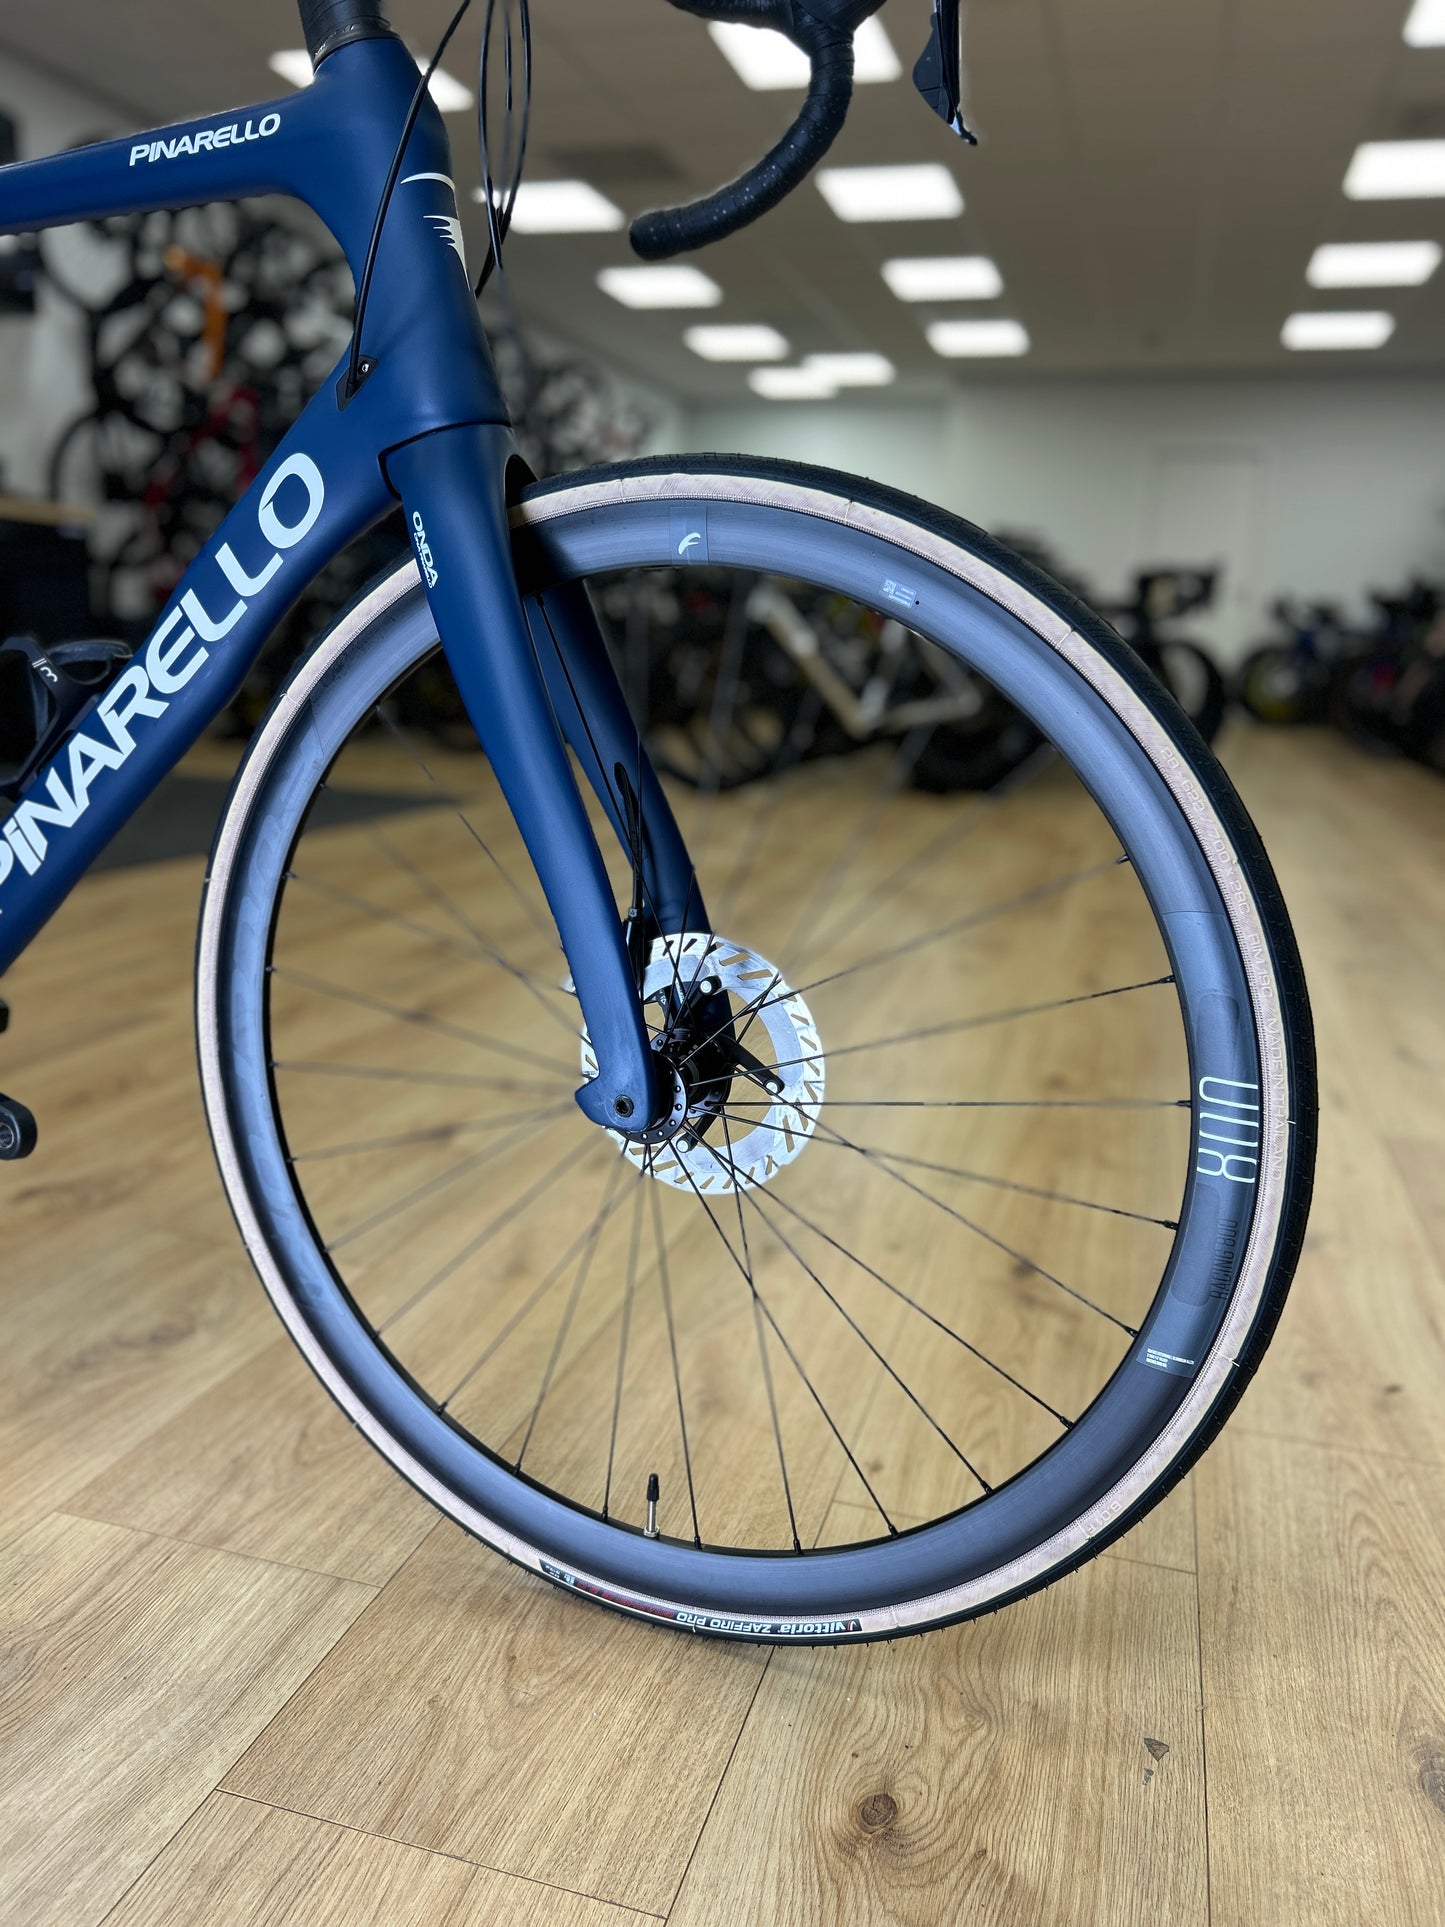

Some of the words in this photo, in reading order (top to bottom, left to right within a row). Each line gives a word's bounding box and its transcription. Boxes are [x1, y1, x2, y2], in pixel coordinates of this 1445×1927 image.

[129, 113, 281, 167] PINARELLO
[413, 511, 439, 587] ONDA
[1160, 747, 1179, 769] 28
[1206, 827, 1230, 863] 700
[1246, 932, 1265, 965] RIM
[1266, 1016, 1283, 1068] MADE
[1271, 1073, 1284, 1089] IN
[1197, 1076, 1259, 1183] 800
[1270, 1094, 1285, 1181] THAILAND
[1217, 1218, 1238, 1249] 800
[1209, 1250, 1235, 1300] RACING
[675, 1610, 706, 1626] PRO
[709, 1616, 772, 1633] ZAFFIRO
[778, 1621, 846, 1634] vittoria
